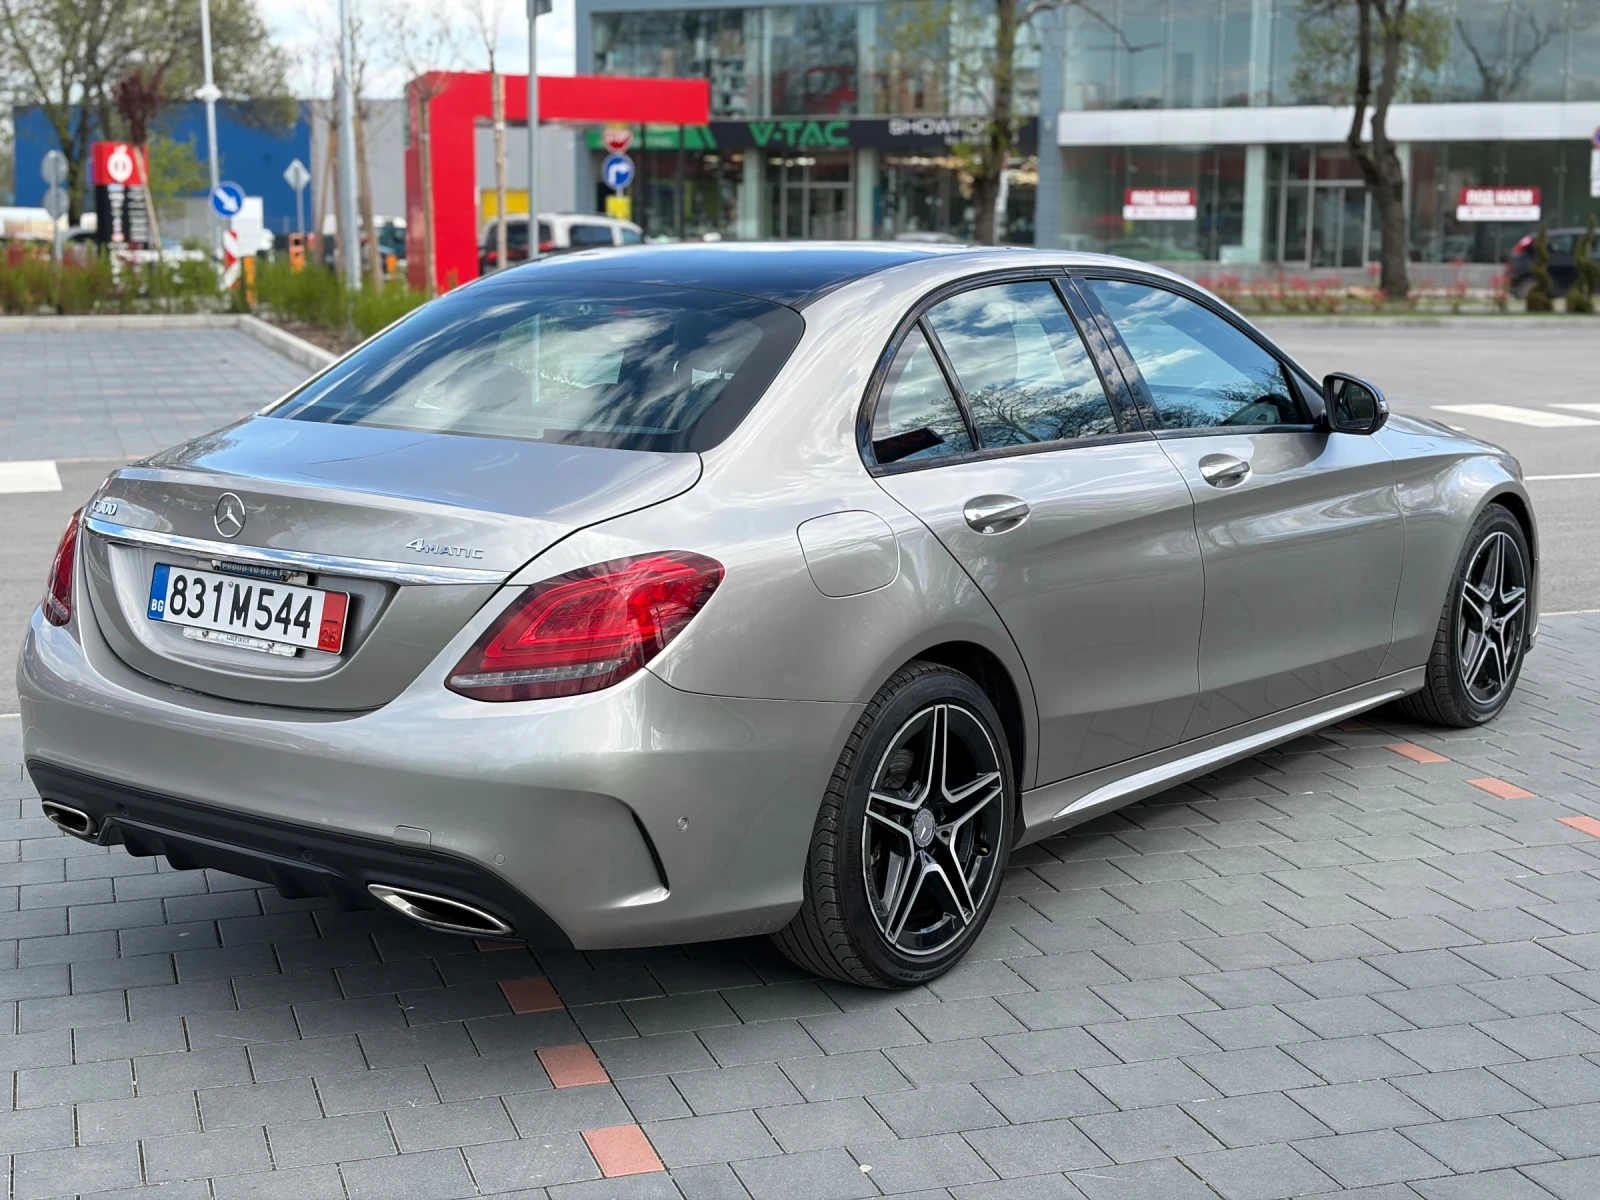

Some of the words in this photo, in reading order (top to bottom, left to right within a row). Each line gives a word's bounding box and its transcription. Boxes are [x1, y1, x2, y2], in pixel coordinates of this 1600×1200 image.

[747, 121, 850, 147] V-TAC
[405, 538, 484, 559] 4MATIC
[221, 562, 247, 572] PROUD
[249, 565, 259, 574] TO
[260, 567, 270, 576] BE
[151, 598, 164, 612] BG
[321, 629, 336, 643] 26
